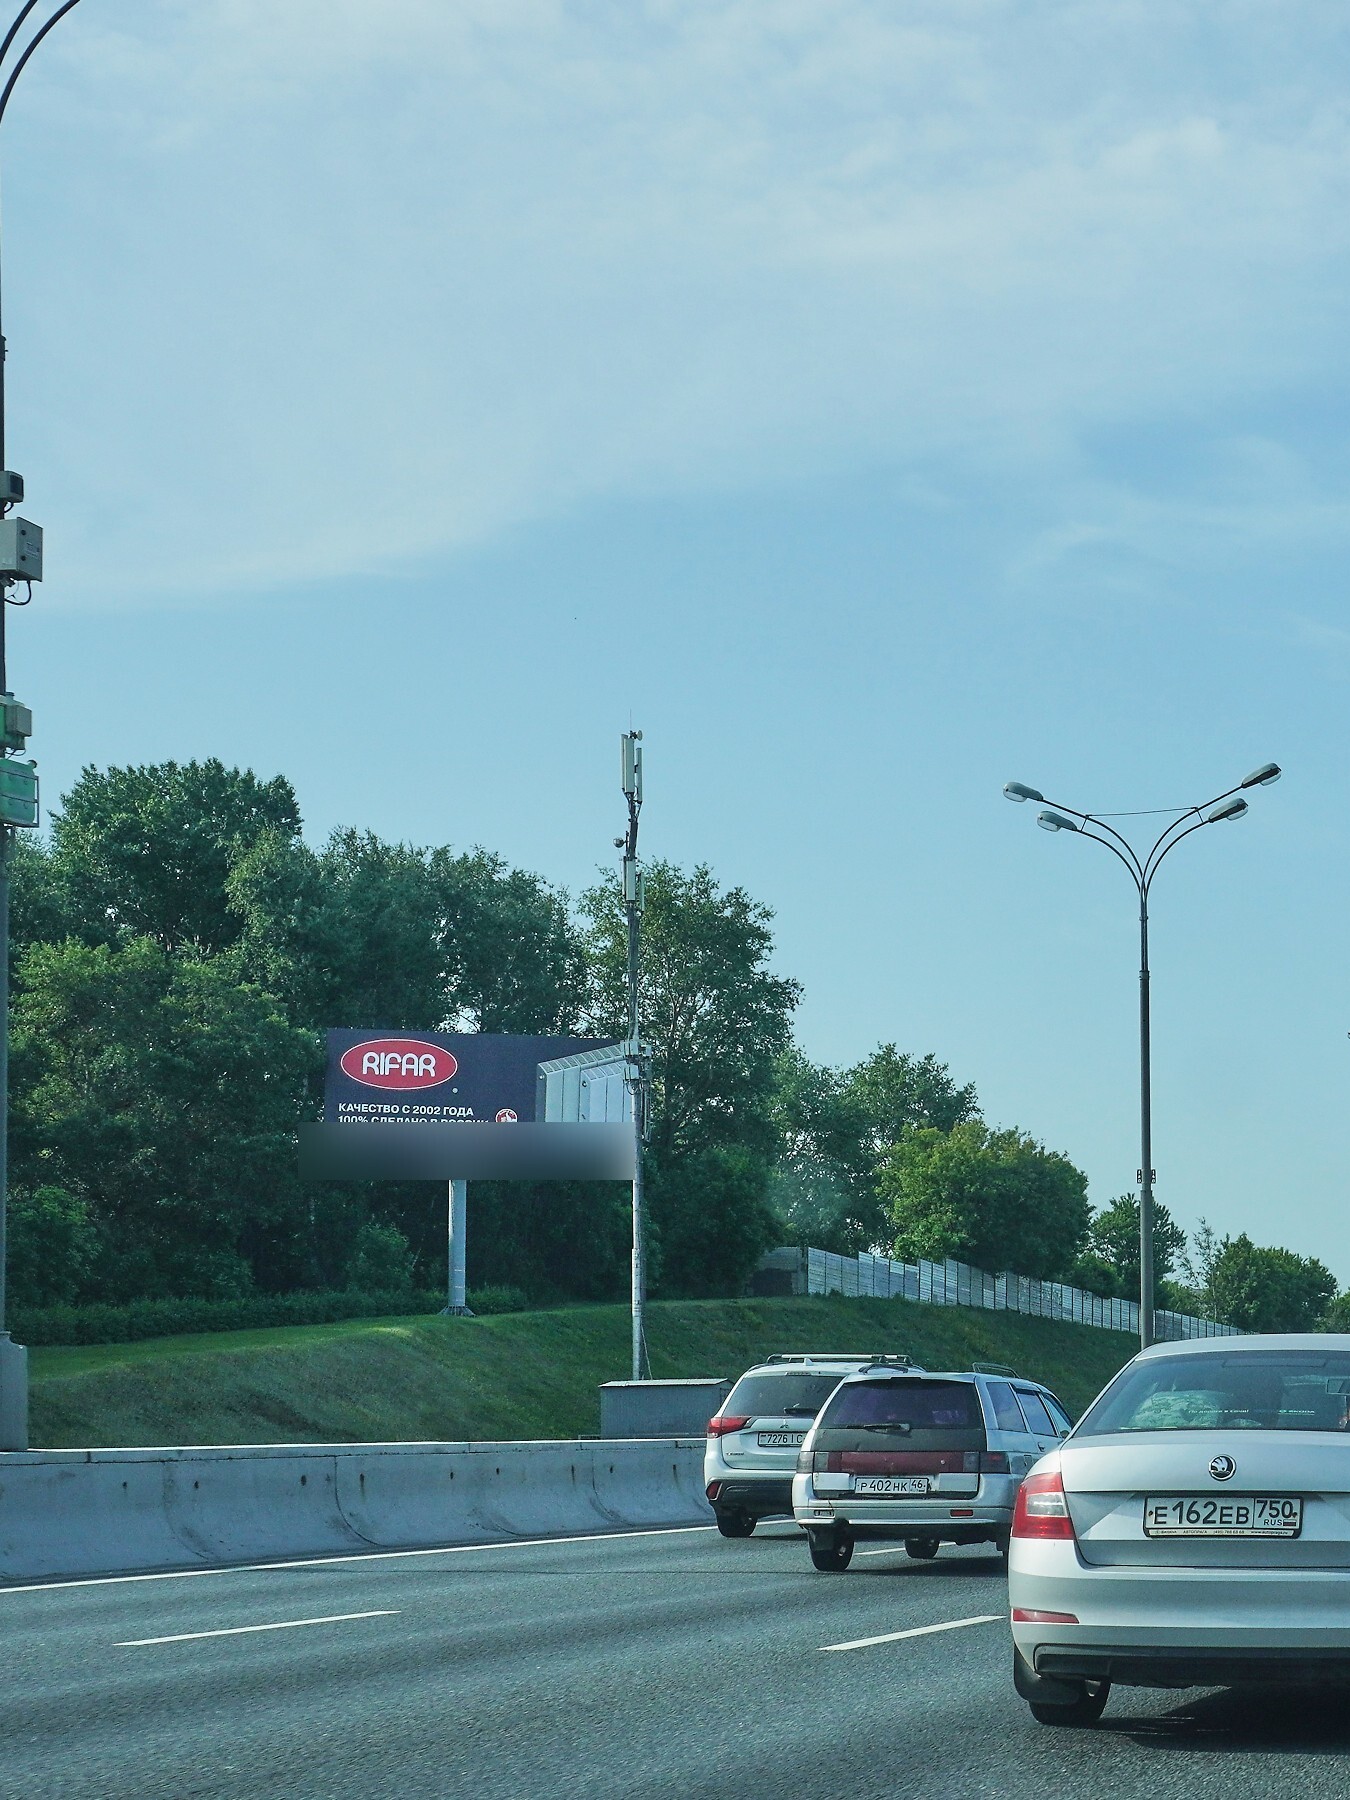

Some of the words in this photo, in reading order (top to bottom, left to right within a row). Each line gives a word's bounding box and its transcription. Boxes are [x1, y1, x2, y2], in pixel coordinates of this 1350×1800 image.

[362, 1051, 436, 1077] RIFAR
[338, 1103, 400, 1114] КАЧЕСТВО
[402, 1105, 411, 1115] С
[412, 1105, 441, 1115] 2002
[443, 1106, 474, 1117] ГОДА
[767, 1434, 788, 1443] 7276
[860, 1480, 908, 1491] Р402НК
[911, 1480, 923, 1489] 46
[1153, 1500, 1250, 1525] Е162ЕВ
[1256, 1500, 1294, 1518] 750
